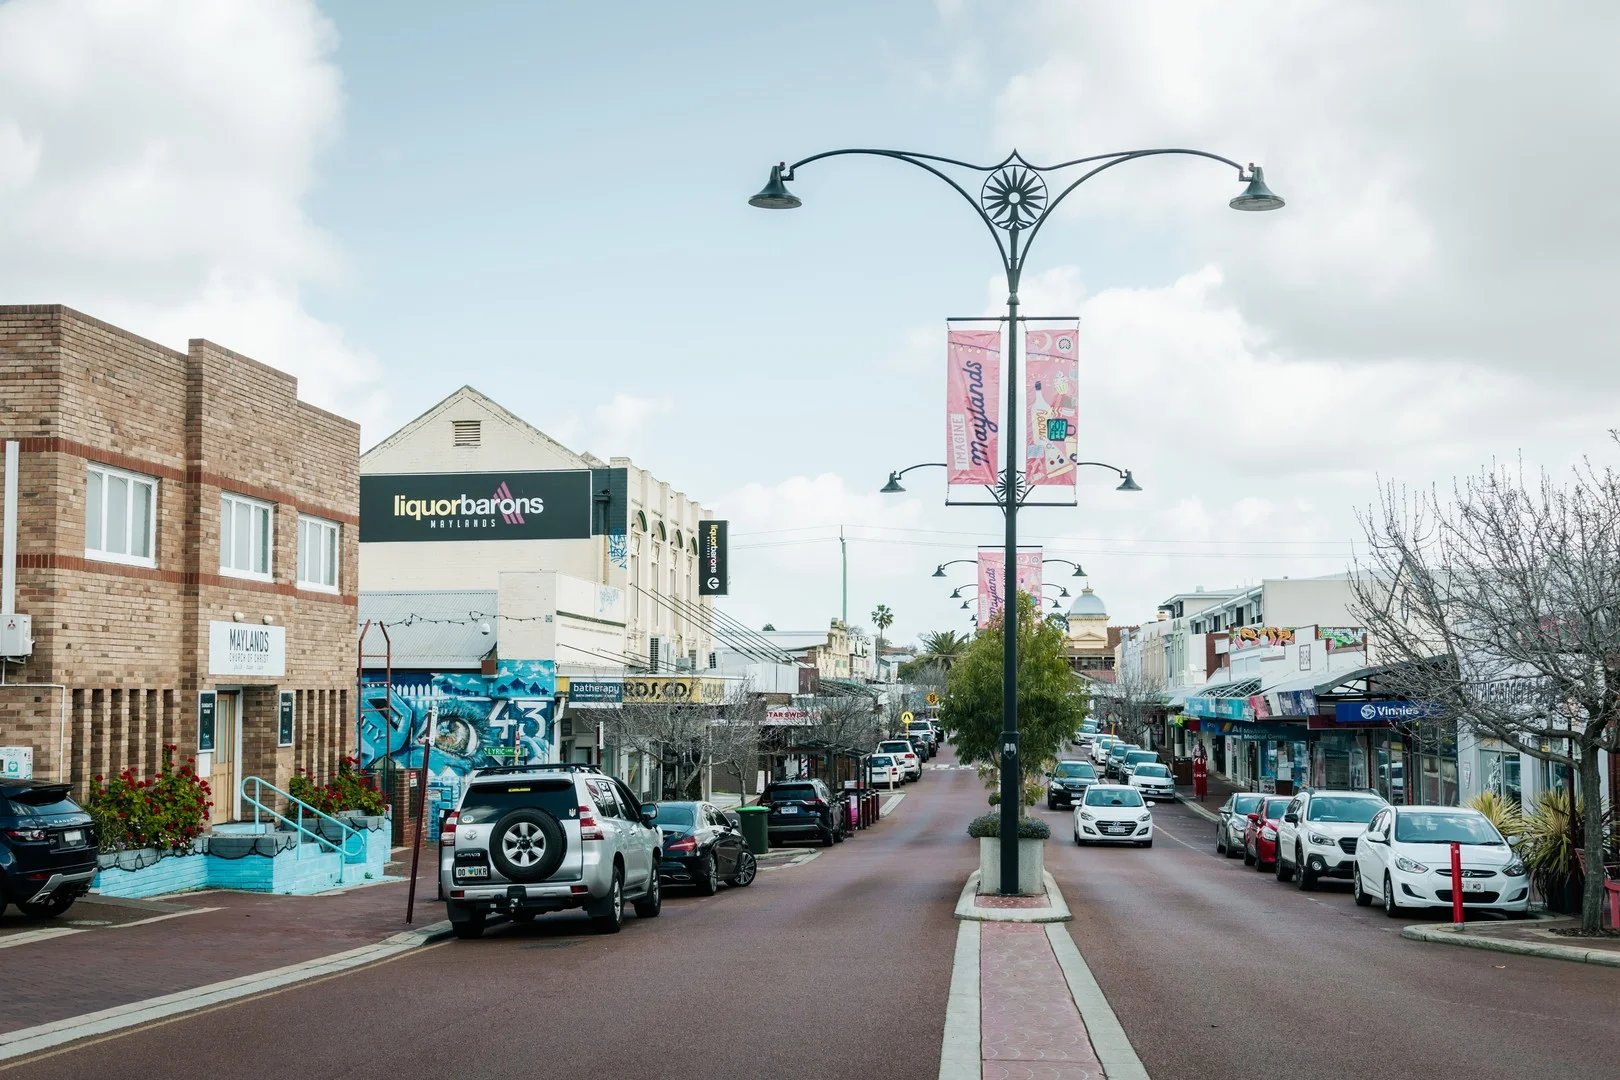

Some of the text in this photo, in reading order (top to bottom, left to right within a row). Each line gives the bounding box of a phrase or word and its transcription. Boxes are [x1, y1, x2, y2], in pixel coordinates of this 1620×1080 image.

[952, 417, 968, 465] IMAGINE
[394, 493, 544, 521] liquorbarons
[430, 519, 496, 529] MAYLANDS
[229, 628, 269, 652] MAYLANDS
[229, 652, 269, 664] CHURCH OF CHRIST
[573, 684, 620, 694] batherapy
[1376, 705, 1420, 716] Vinnies
[488, 700, 547, 740] 43
